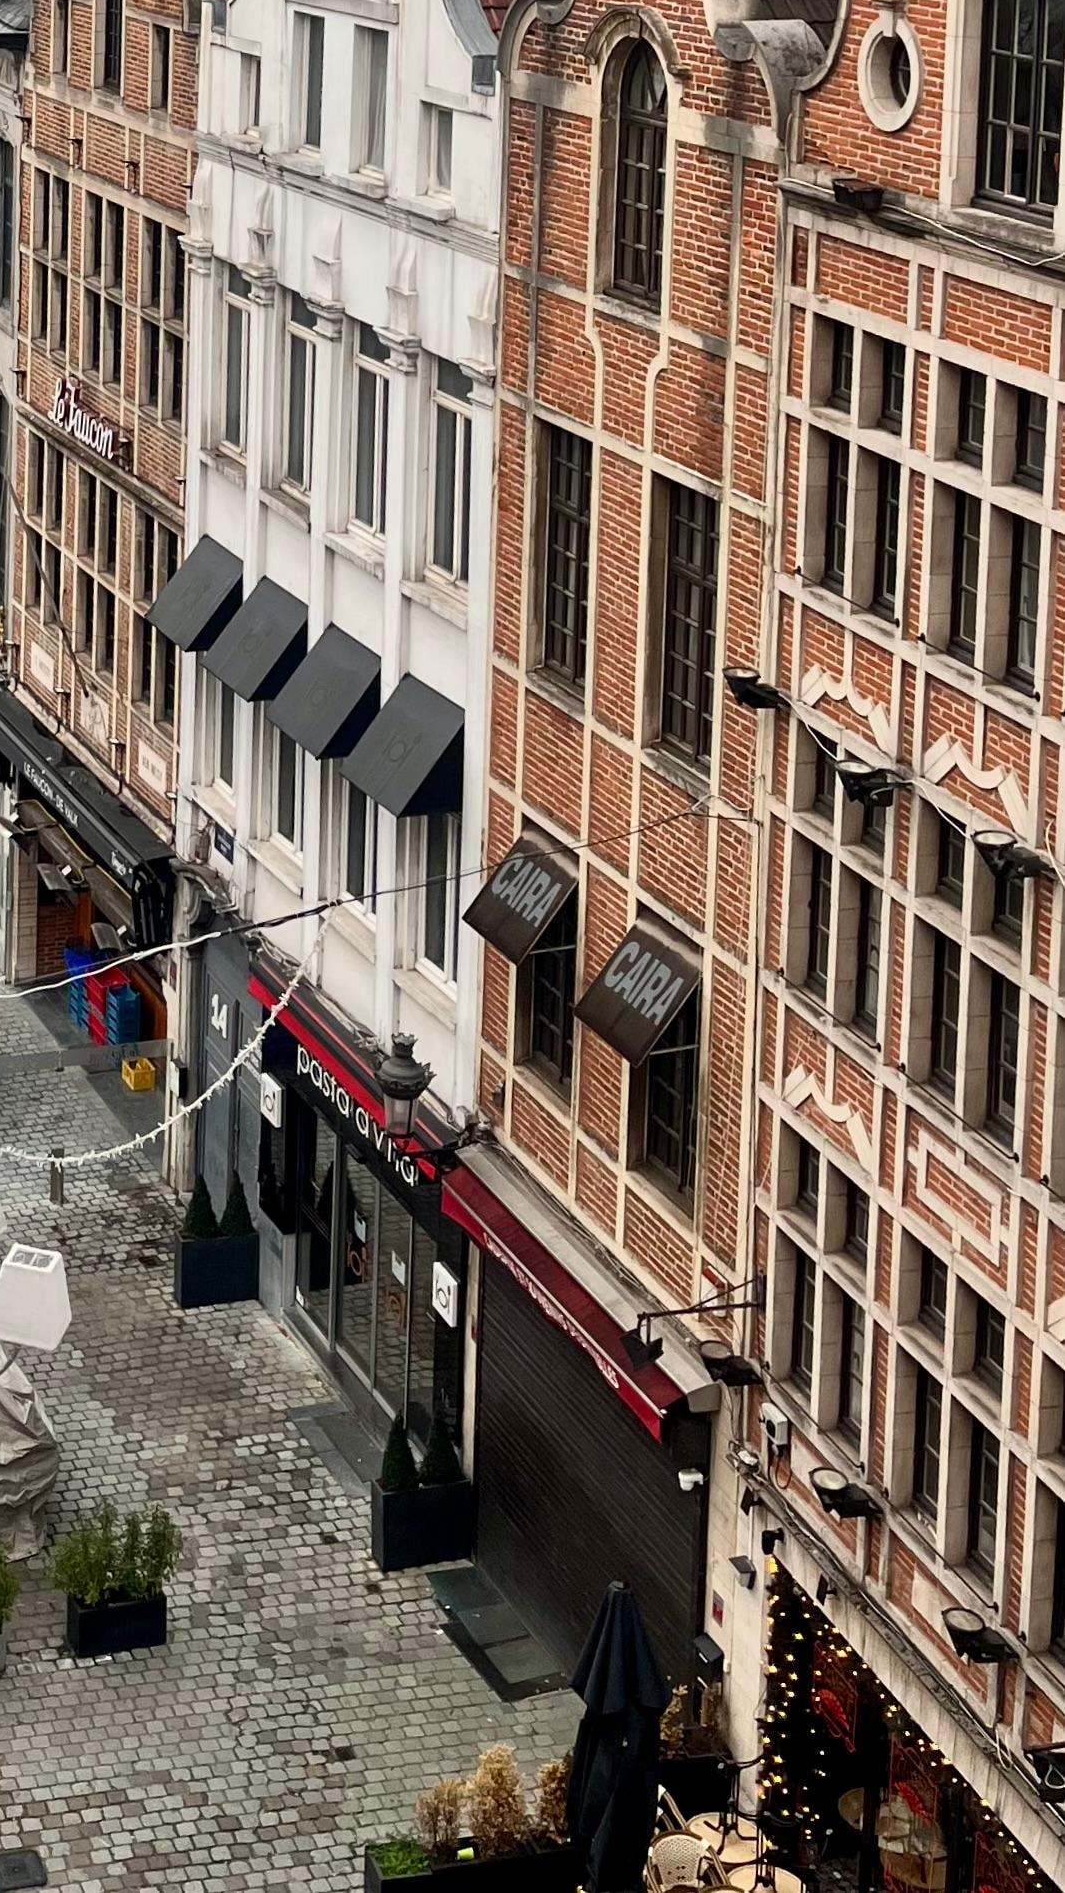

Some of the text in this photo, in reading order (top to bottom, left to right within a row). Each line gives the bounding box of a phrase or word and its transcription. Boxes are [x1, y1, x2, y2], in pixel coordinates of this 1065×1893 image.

[48, 378, 65, 427] Le
[491, 853, 562, 928] CAIRA
[211, 994, 228, 1039] 14
[604, 941, 684, 1026] CAIRA
[297, 1044, 350, 1119] pasta
